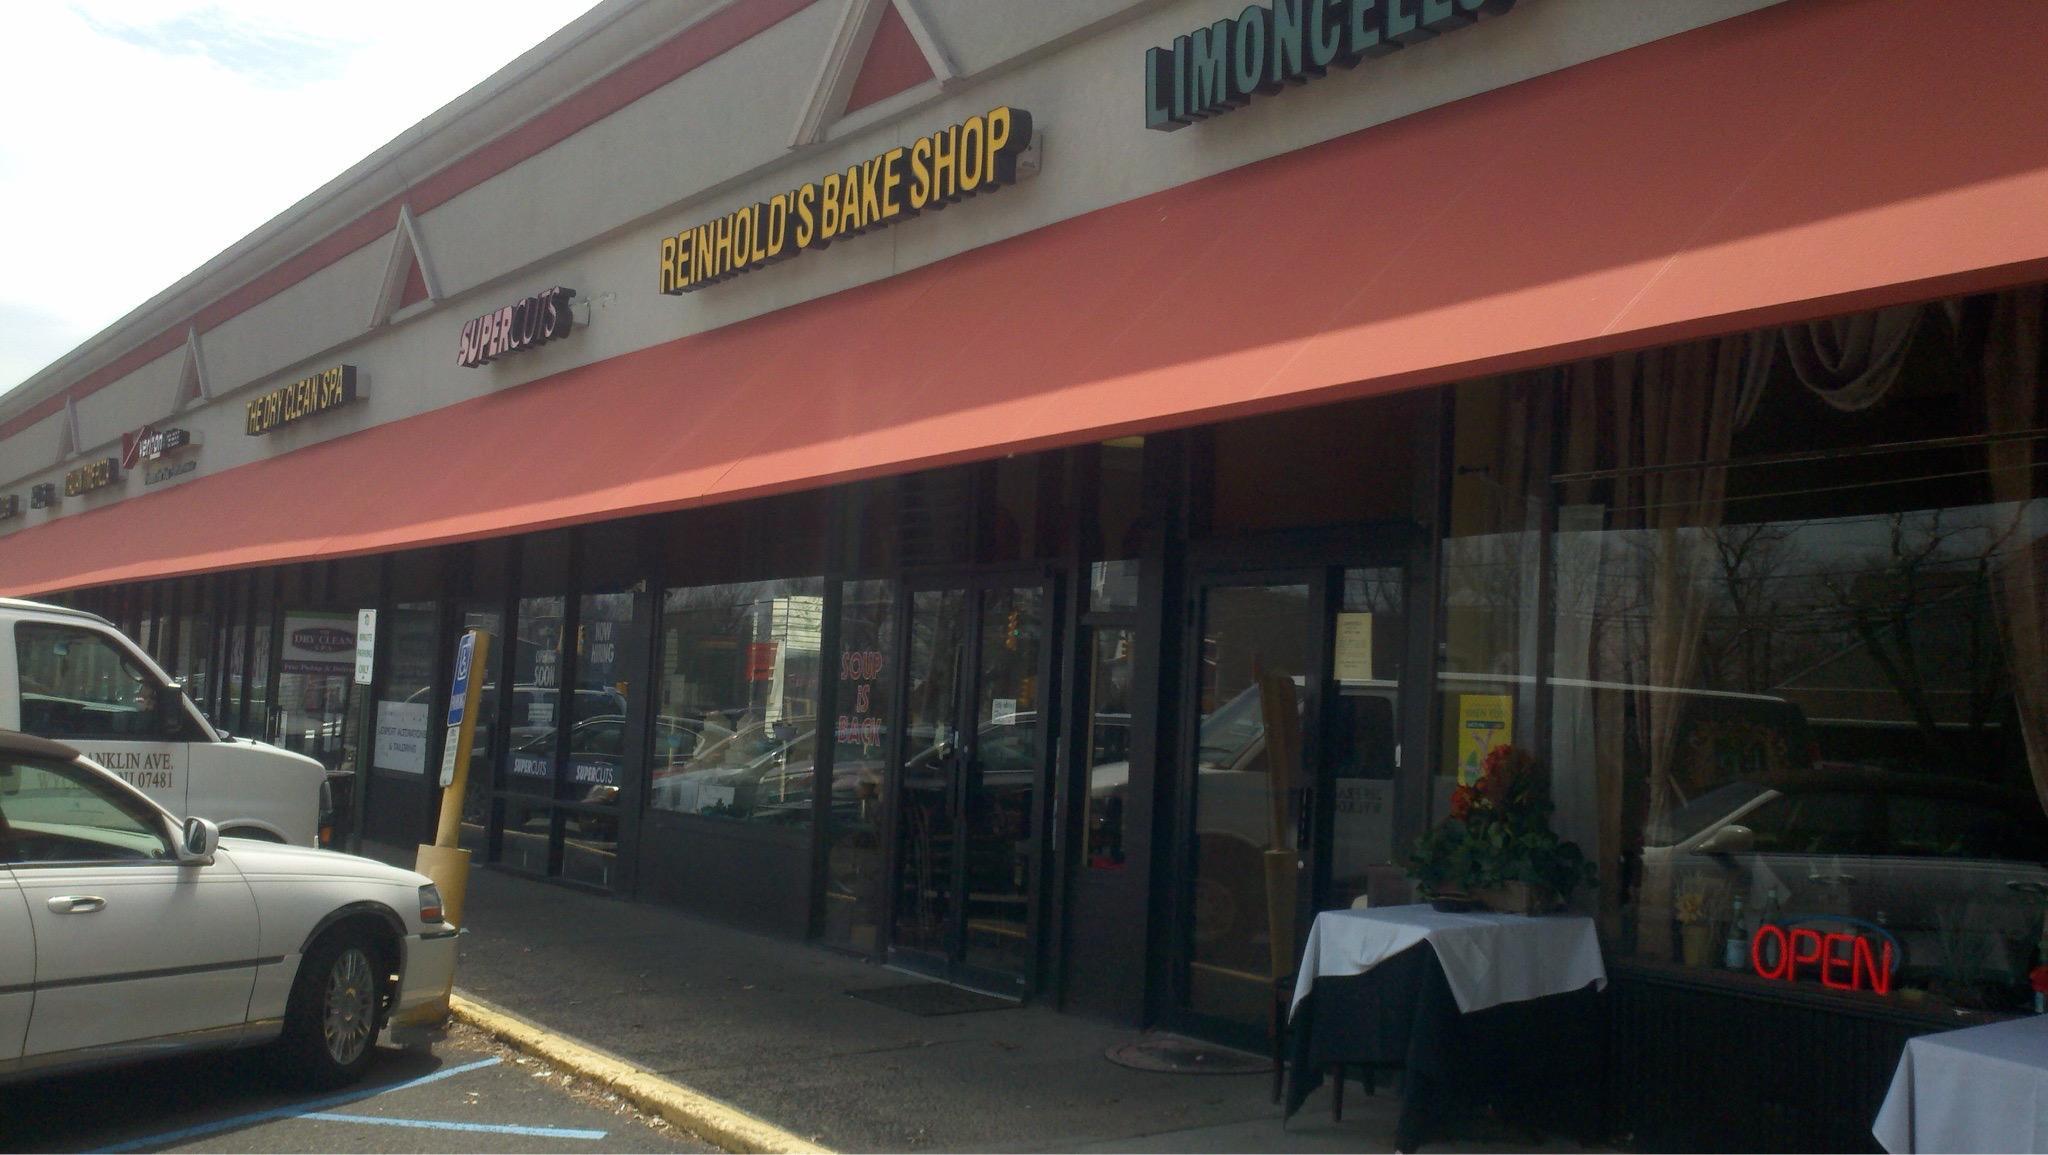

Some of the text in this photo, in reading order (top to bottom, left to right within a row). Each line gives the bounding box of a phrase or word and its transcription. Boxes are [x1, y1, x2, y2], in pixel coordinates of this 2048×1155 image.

[1145, 0, 1485, 130] LIMONCE
[659, 105, 1012, 295] REINHOLD'S BAKE SHOP
[457, 286, 562, 368] SUPERCUTS
[246, 364, 344, 435] THE DRY CLEAN SPA
[534, 665, 556, 687] SOON
[840, 650, 882, 681] SOUP
[838, 715, 882, 747] BACK
[144, 752, 174, 770] AVE.
[513, 758, 548, 777] SUPERCUTS
[575, 764, 614, 784] SUPERCUTS
[138, 772, 173, 789] 07481
[1752, 923, 1893, 996] OPEN
